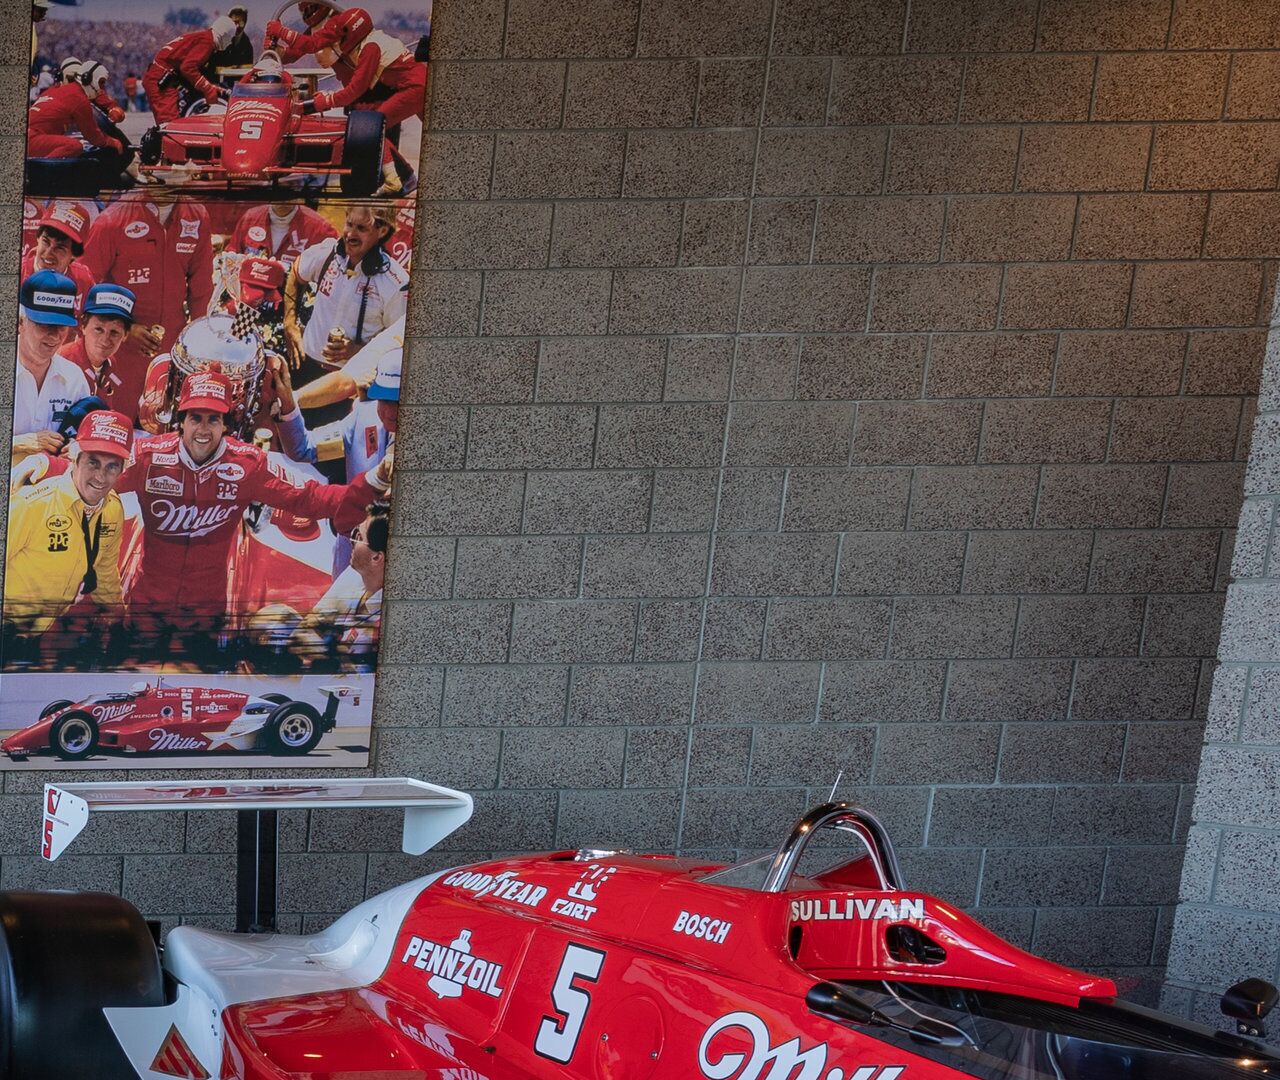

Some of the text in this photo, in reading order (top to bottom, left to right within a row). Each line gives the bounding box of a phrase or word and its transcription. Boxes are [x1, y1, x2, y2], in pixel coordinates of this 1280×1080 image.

[230, 113, 277, 122] AMERICAN
[239, 120, 264, 141] 5
[149, 479, 181, 492] Marlboro
[151, 500, 239, 532] Miller
[156, 690, 163, 699] 5
[91, 703, 138, 724] Miller
[181, 700, 193, 718] 5
[148, 727, 207, 751] Miller
[42, 818, 54, 860] 5
[442, 868, 548, 909] GOODYEAR
[550, 897, 599, 922] CART
[790, 898, 926, 922] SULLIVAN
[671, 910, 733, 945] BOSCH
[401, 935, 506, 999] PENNZOIL
[534, 942, 608, 1065] 5
